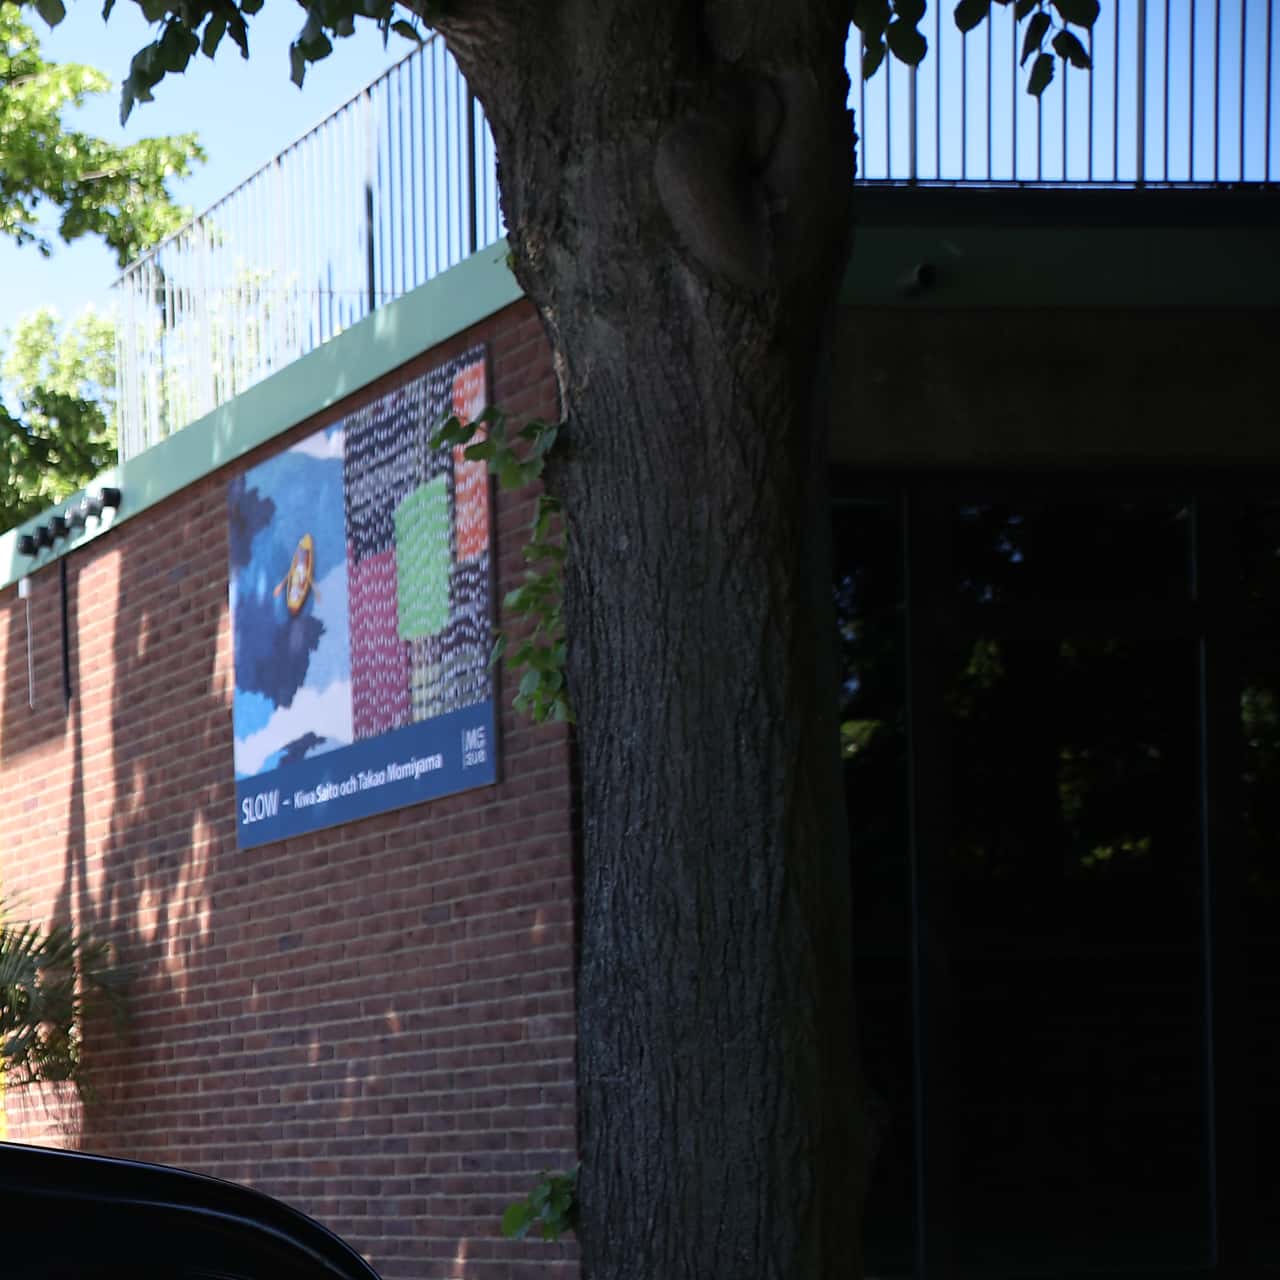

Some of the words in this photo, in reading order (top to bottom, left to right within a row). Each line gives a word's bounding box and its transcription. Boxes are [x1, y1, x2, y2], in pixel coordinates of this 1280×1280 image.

[242, 789, 279, 825] SLOW
[294, 789, 315, 808] Kiwa
[316, 783, 339, 803] Saito
[340, 775, 357, 796] och
[358, 769, 385, 790] Takao
[386, 753, 443, 782] Momiyama
